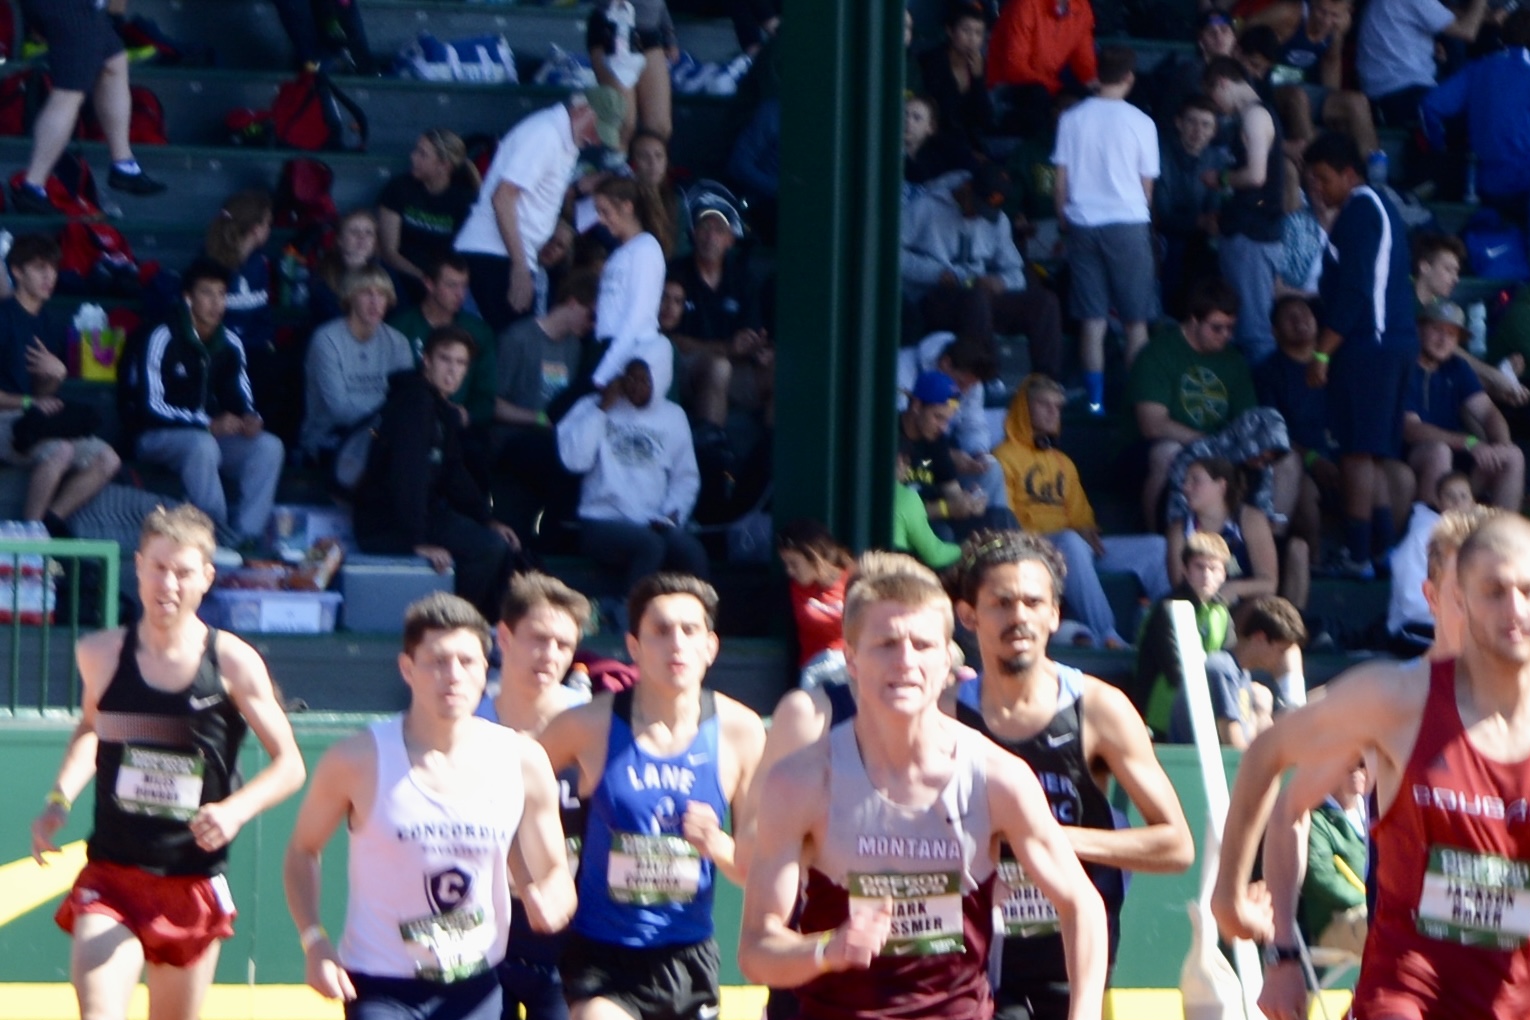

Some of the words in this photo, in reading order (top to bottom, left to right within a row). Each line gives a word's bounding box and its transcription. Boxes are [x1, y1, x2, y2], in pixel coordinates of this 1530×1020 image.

[627, 762, 696, 796] LANE
[397, 822, 506, 841] CONCORDIA
[857, 835, 962, 859] MONTANA
[890, 916, 943, 936] SSMER
